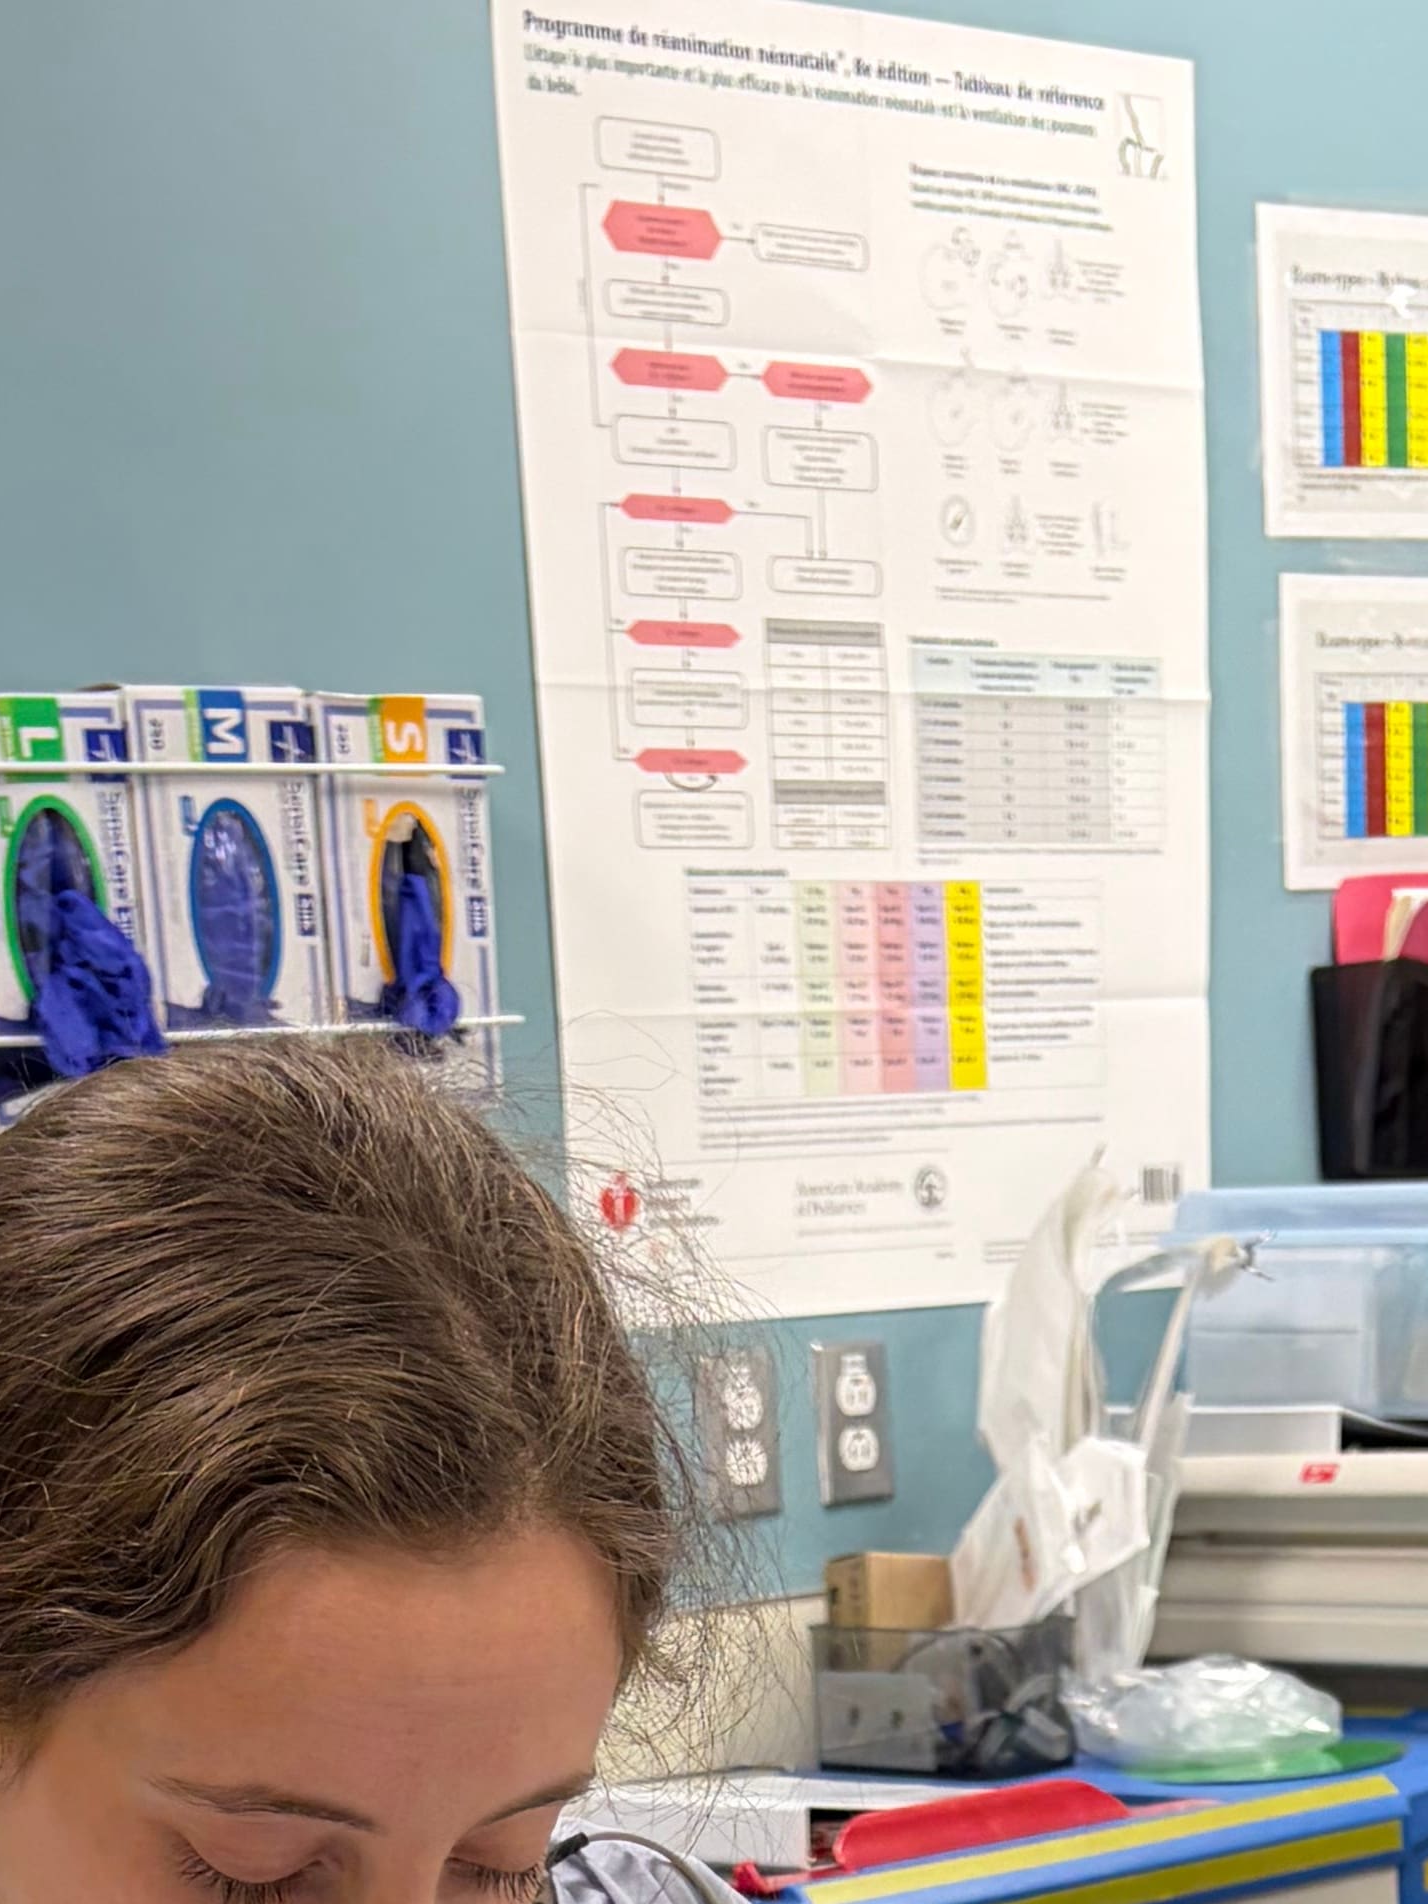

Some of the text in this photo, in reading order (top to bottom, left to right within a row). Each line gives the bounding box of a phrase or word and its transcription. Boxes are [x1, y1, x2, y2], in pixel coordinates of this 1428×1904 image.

[20, 726, 58, 759] L
[204, 708, 245, 755] M
[385, 719, 424, 754] S
